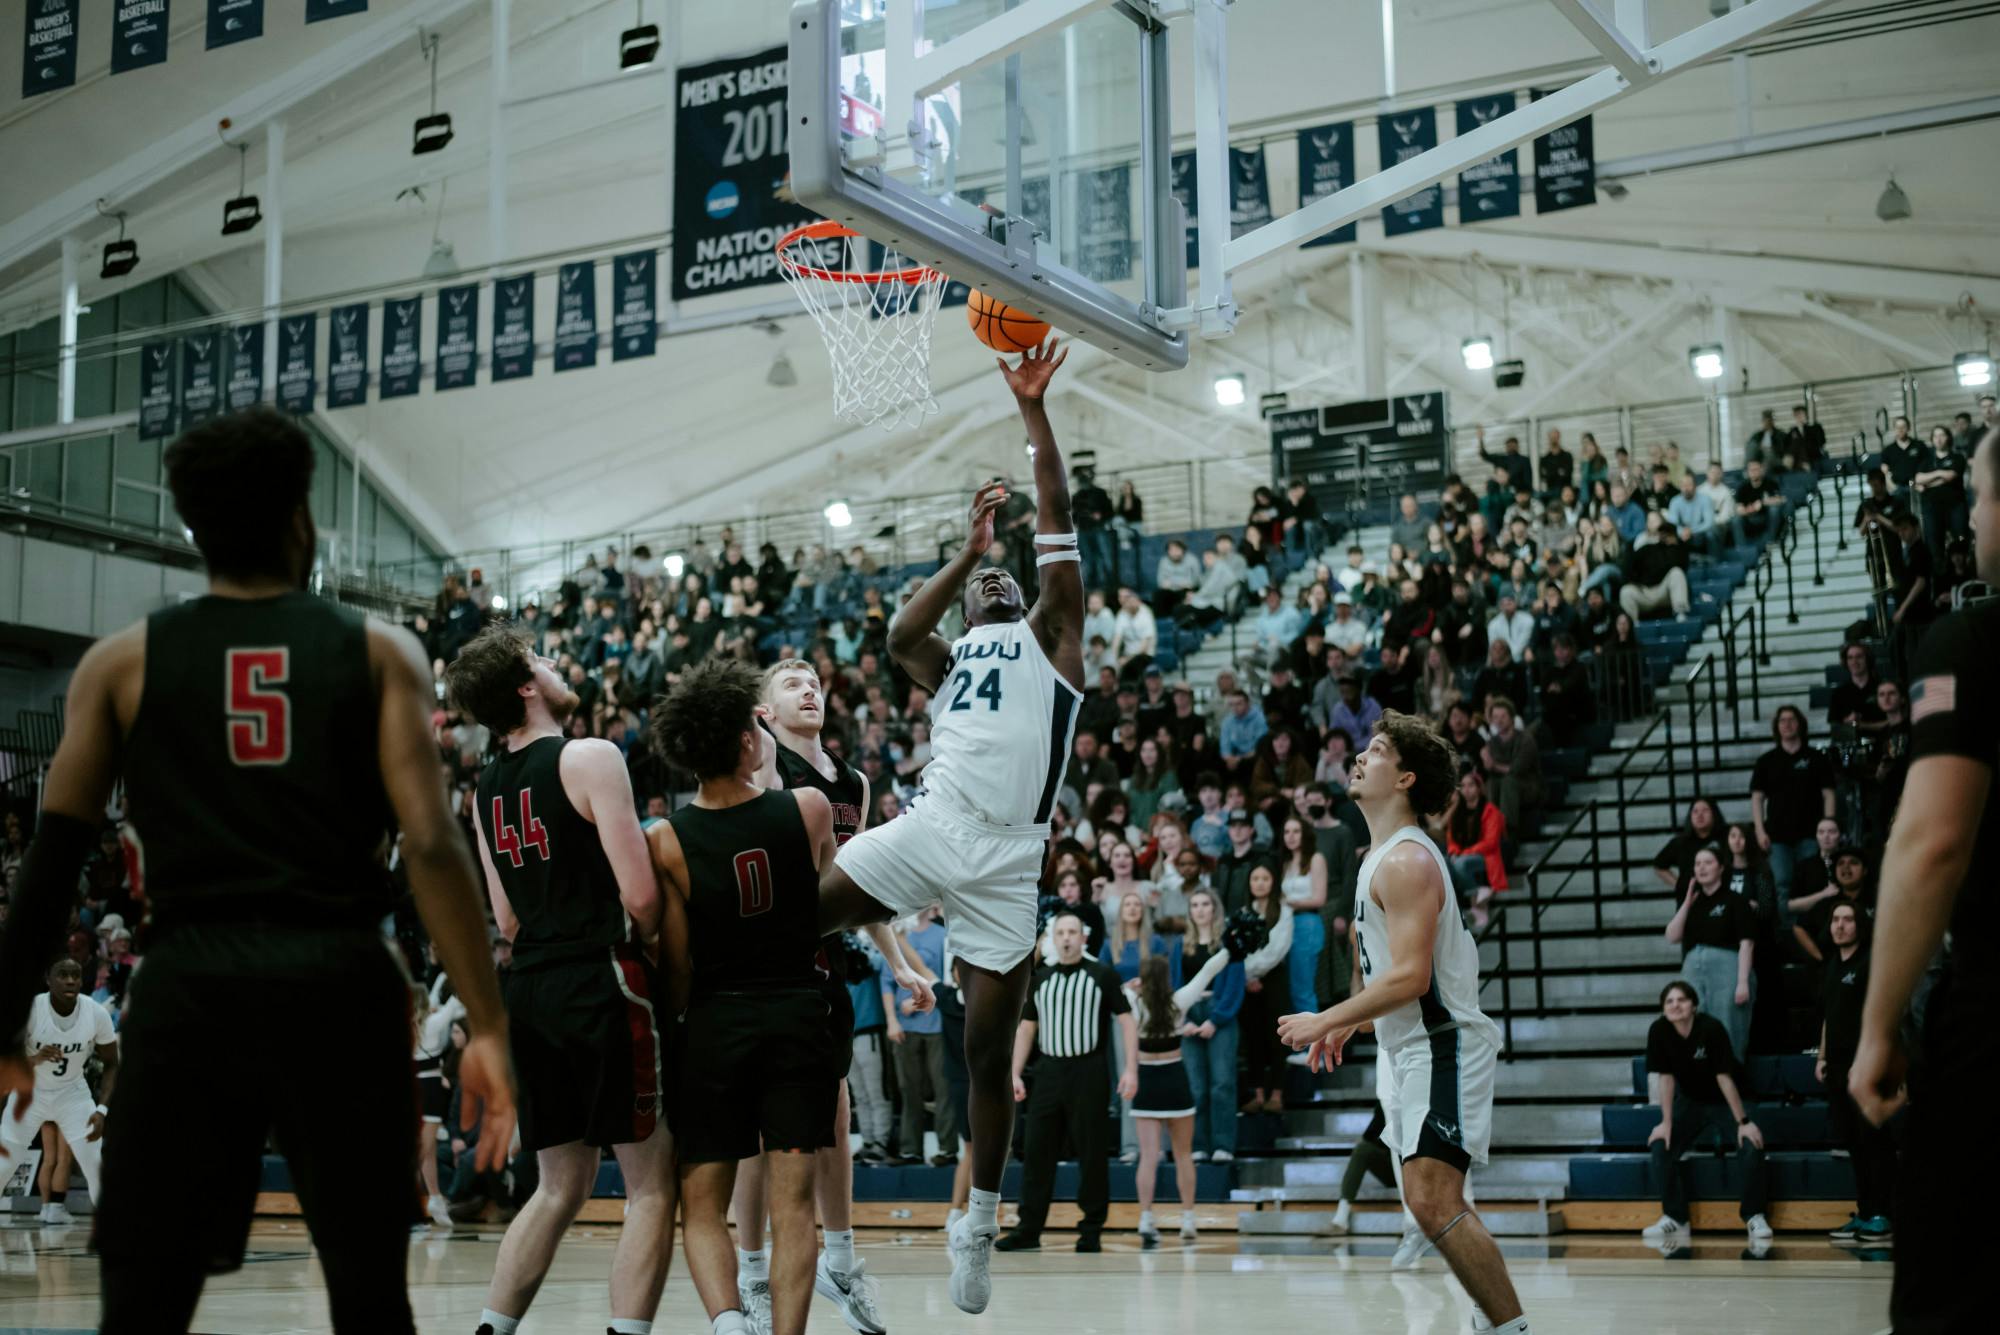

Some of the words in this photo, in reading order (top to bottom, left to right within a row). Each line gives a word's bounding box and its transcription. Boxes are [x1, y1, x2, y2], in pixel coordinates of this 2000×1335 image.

[34, 10, 70, 31] WOMEN'S
[118, 0, 165, 22] BASKETBALL
[29, 23, 73, 46] BASKETBALL
[681, 71, 737, 108] MEN'S
[722, 100, 789, 167] 201
[225, 646, 291, 766] 5
[949, 668, 1002, 712] 24
[492, 787, 550, 868] 44
[733, 848, 773, 918] 0
[52, 1057, 69, 1077] 3
